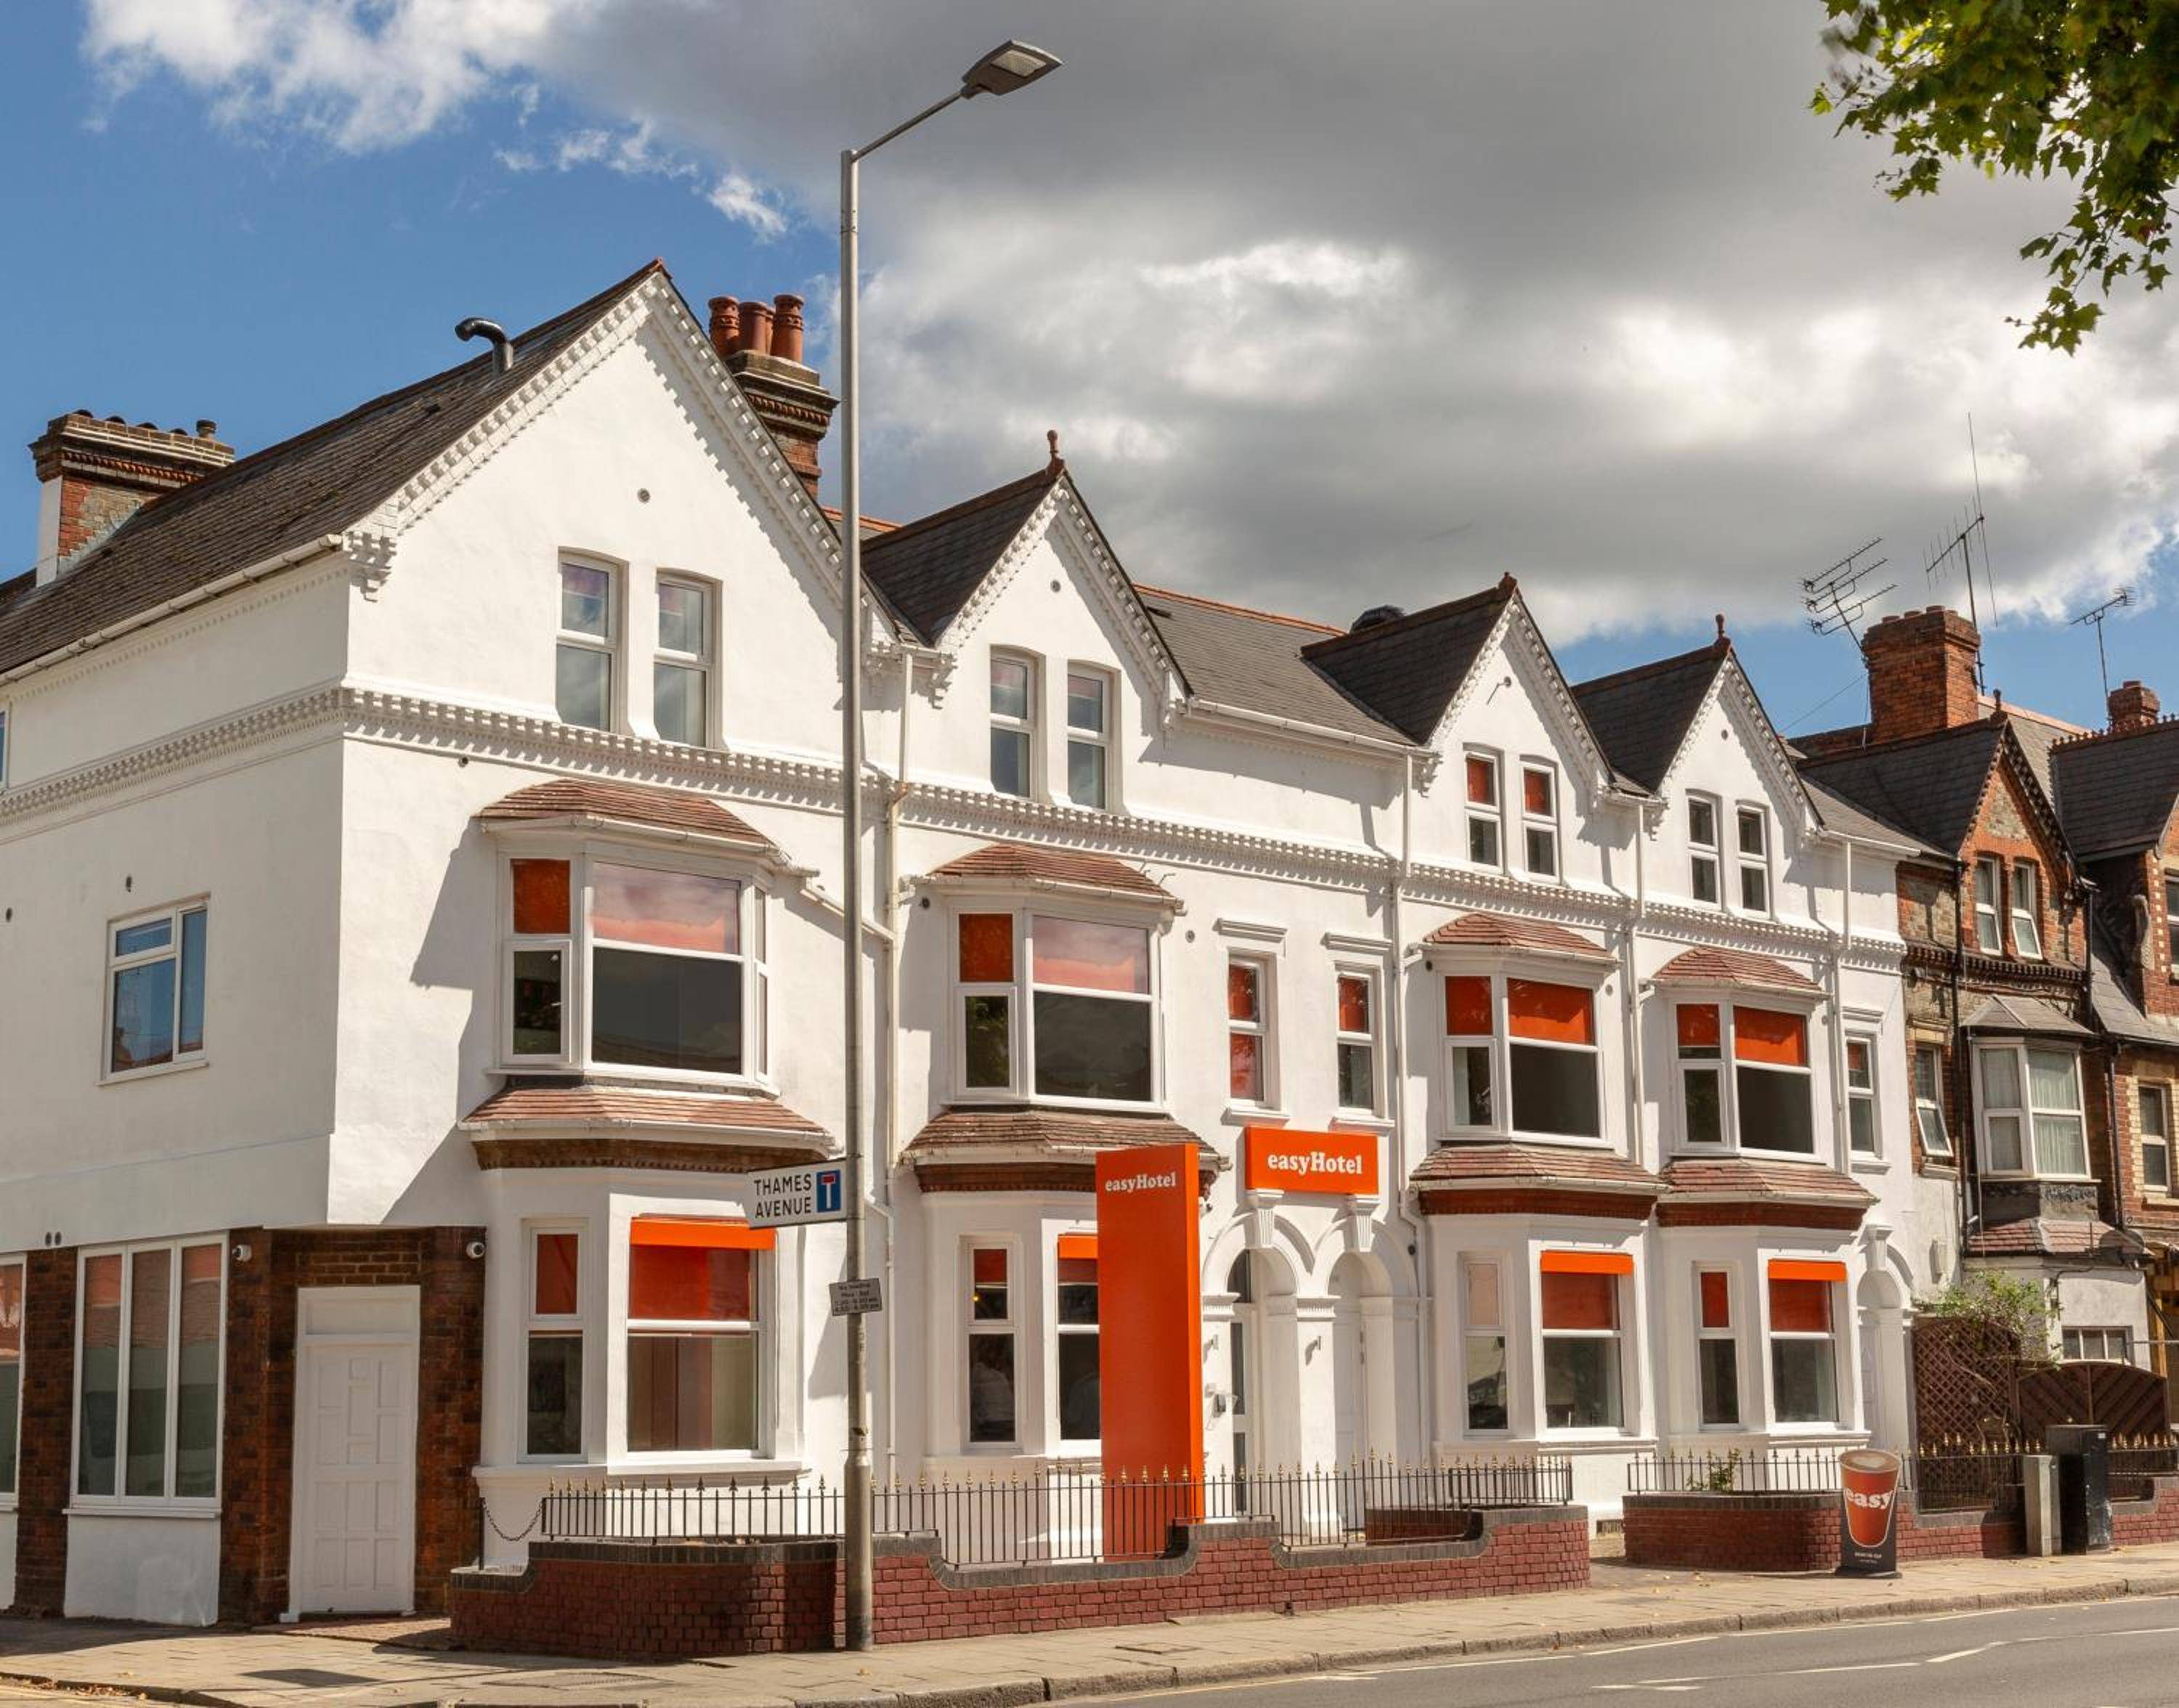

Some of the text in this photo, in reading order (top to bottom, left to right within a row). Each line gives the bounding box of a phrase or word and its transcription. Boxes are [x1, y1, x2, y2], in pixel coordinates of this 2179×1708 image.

[1267, 1151, 1363, 1176] easyHotel
[754, 1173, 812, 1196] THAMES
[1105, 1171, 1176, 1193] easyHotel
[755, 1196, 812, 1219] AVENUE
[1844, 1487, 1894, 1510] easy
